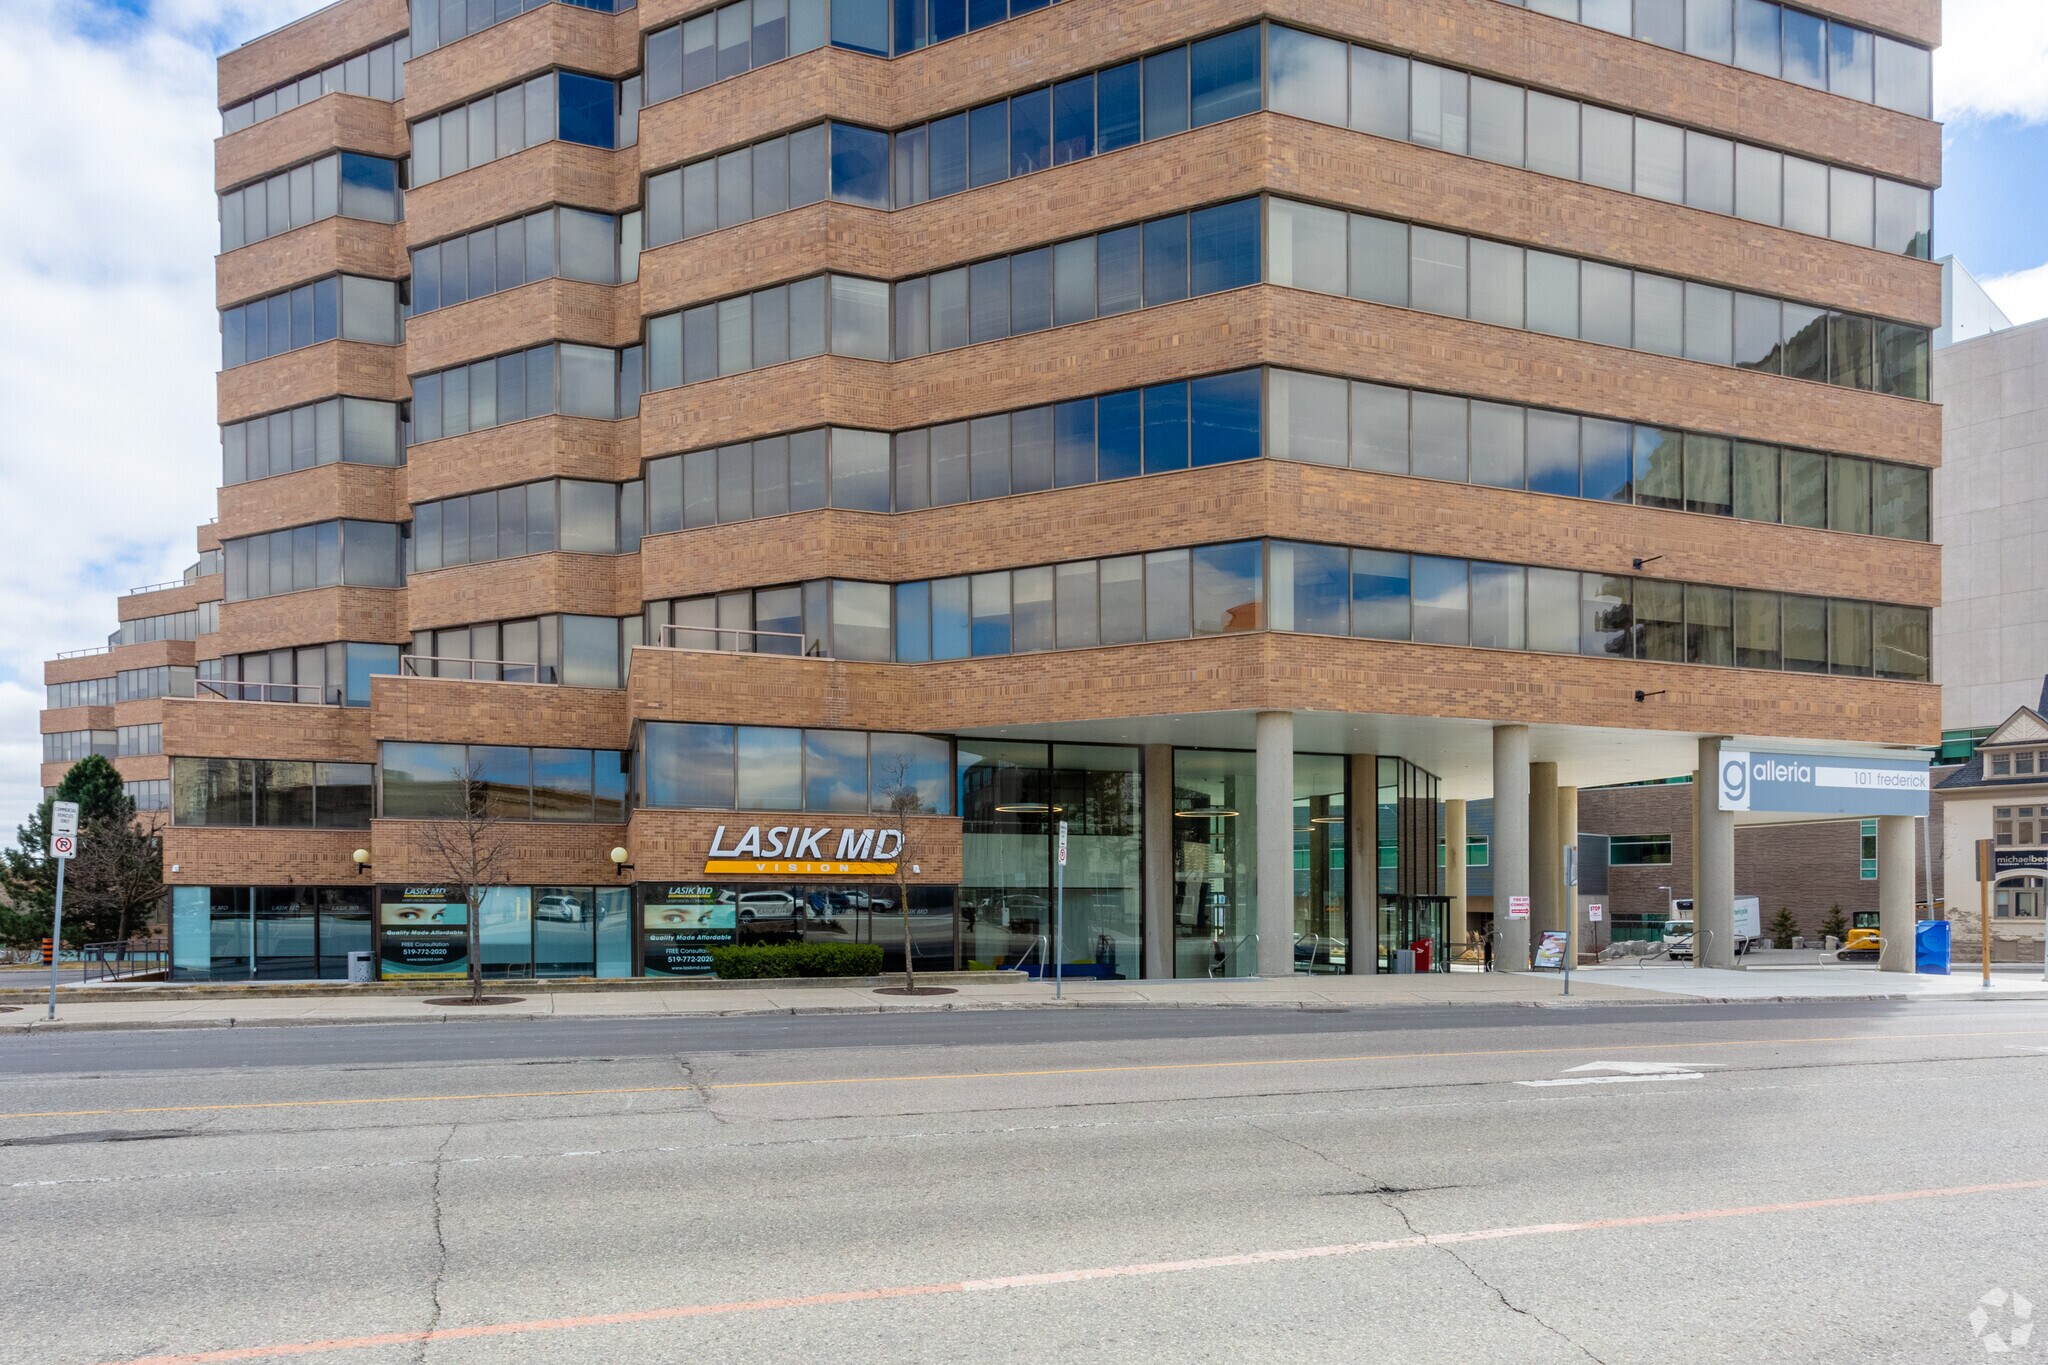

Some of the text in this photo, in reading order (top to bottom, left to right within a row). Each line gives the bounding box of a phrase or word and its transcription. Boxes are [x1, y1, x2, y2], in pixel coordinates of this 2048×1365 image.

[1854, 771, 1872, 785] 101
[1877, 773, 1926, 788] frederick
[708, 825, 906, 860] LASIK MD
[756, 863, 849, 872] VISION
